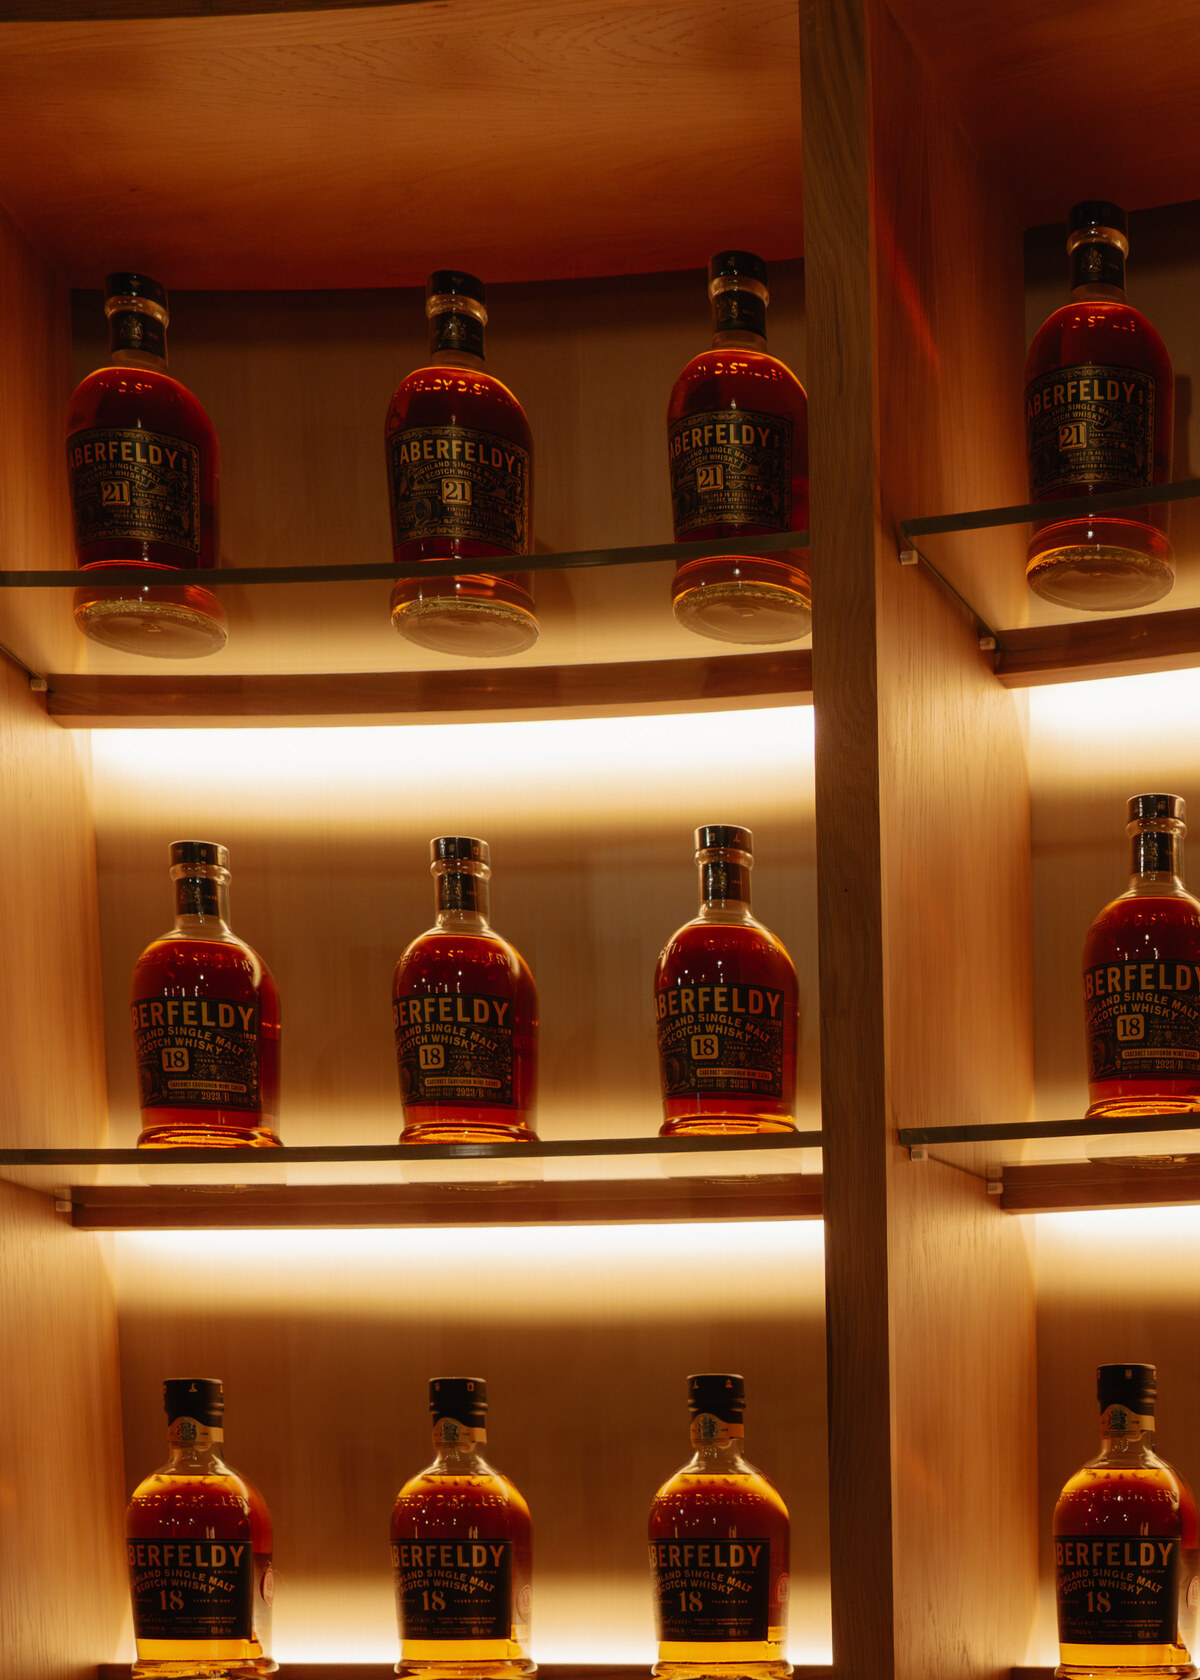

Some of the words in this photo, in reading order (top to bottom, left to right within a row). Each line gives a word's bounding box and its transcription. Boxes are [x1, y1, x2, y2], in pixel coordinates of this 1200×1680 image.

[1068, 402, 1096, 412] SINGLE
[1073, 411, 1102, 421] WHISKY
[1062, 426, 1083, 447] 21
[400, 439, 515, 473] ABERFELDY
[699, 469, 720, 488] 21
[104, 484, 125, 502] 21
[445, 481, 470, 501] 21
[132, 1001, 254, 1031] BERFELDY
[393, 998, 509, 1031] BERFELDY
[1124, 992, 1169, 1005] SINGLE
[1171, 999, 1198, 1019] MALT
[1131, 1003, 1179, 1020] WHISKY
[425, 1024, 467, 1037] SINGLE
[470, 1032, 498, 1052] MALT
[698, 1013, 742, 1027] SINGLE
[744, 1022, 771, 1043] MALT
[705, 1024, 751, 1042] WHISKY
[1120, 1018, 1140, 1037] 18
[168, 1026, 212, 1040] SINGLE
[216, 1036, 244, 1056] MALT
[175, 1037, 222, 1055] WHISKY
[431, 1034, 477, 1051] WHISKY
[694, 1038, 714, 1055] 18
[164, 1051, 185, 1068] 18
[421, 1048, 441, 1065] 18
[129, 1544, 244, 1568] BERFELDY
[391, 1544, 504, 1568] BERFELDY
[1056, 1542, 1173, 1567] BERFELDY
[165, 1569, 206, 1581] SINGLE
[208, 1576, 235, 1592] MALT
[171, 1579, 215, 1594] WHISKY
[427, 1569, 467, 1582] SINGLE
[469, 1576, 496, 1593] MALT
[432, 1579, 477, 1594] WHISKY
[685, 1570, 725, 1582] SINGLE
[726, 1577, 752, 1593] MALT
[691, 1580, 733, 1595] WHISKY
[1092, 1569, 1134, 1582] SINGLE
[1136, 1576, 1163, 1593] MALT
[1100, 1579, 1142, 1595] WHISKY
[160, 1589, 185, 1610] 18
[421, 1589, 446, 1611] 18
[680, 1591, 704, 1612] 18
[1086, 1591, 1112, 1613] 18
